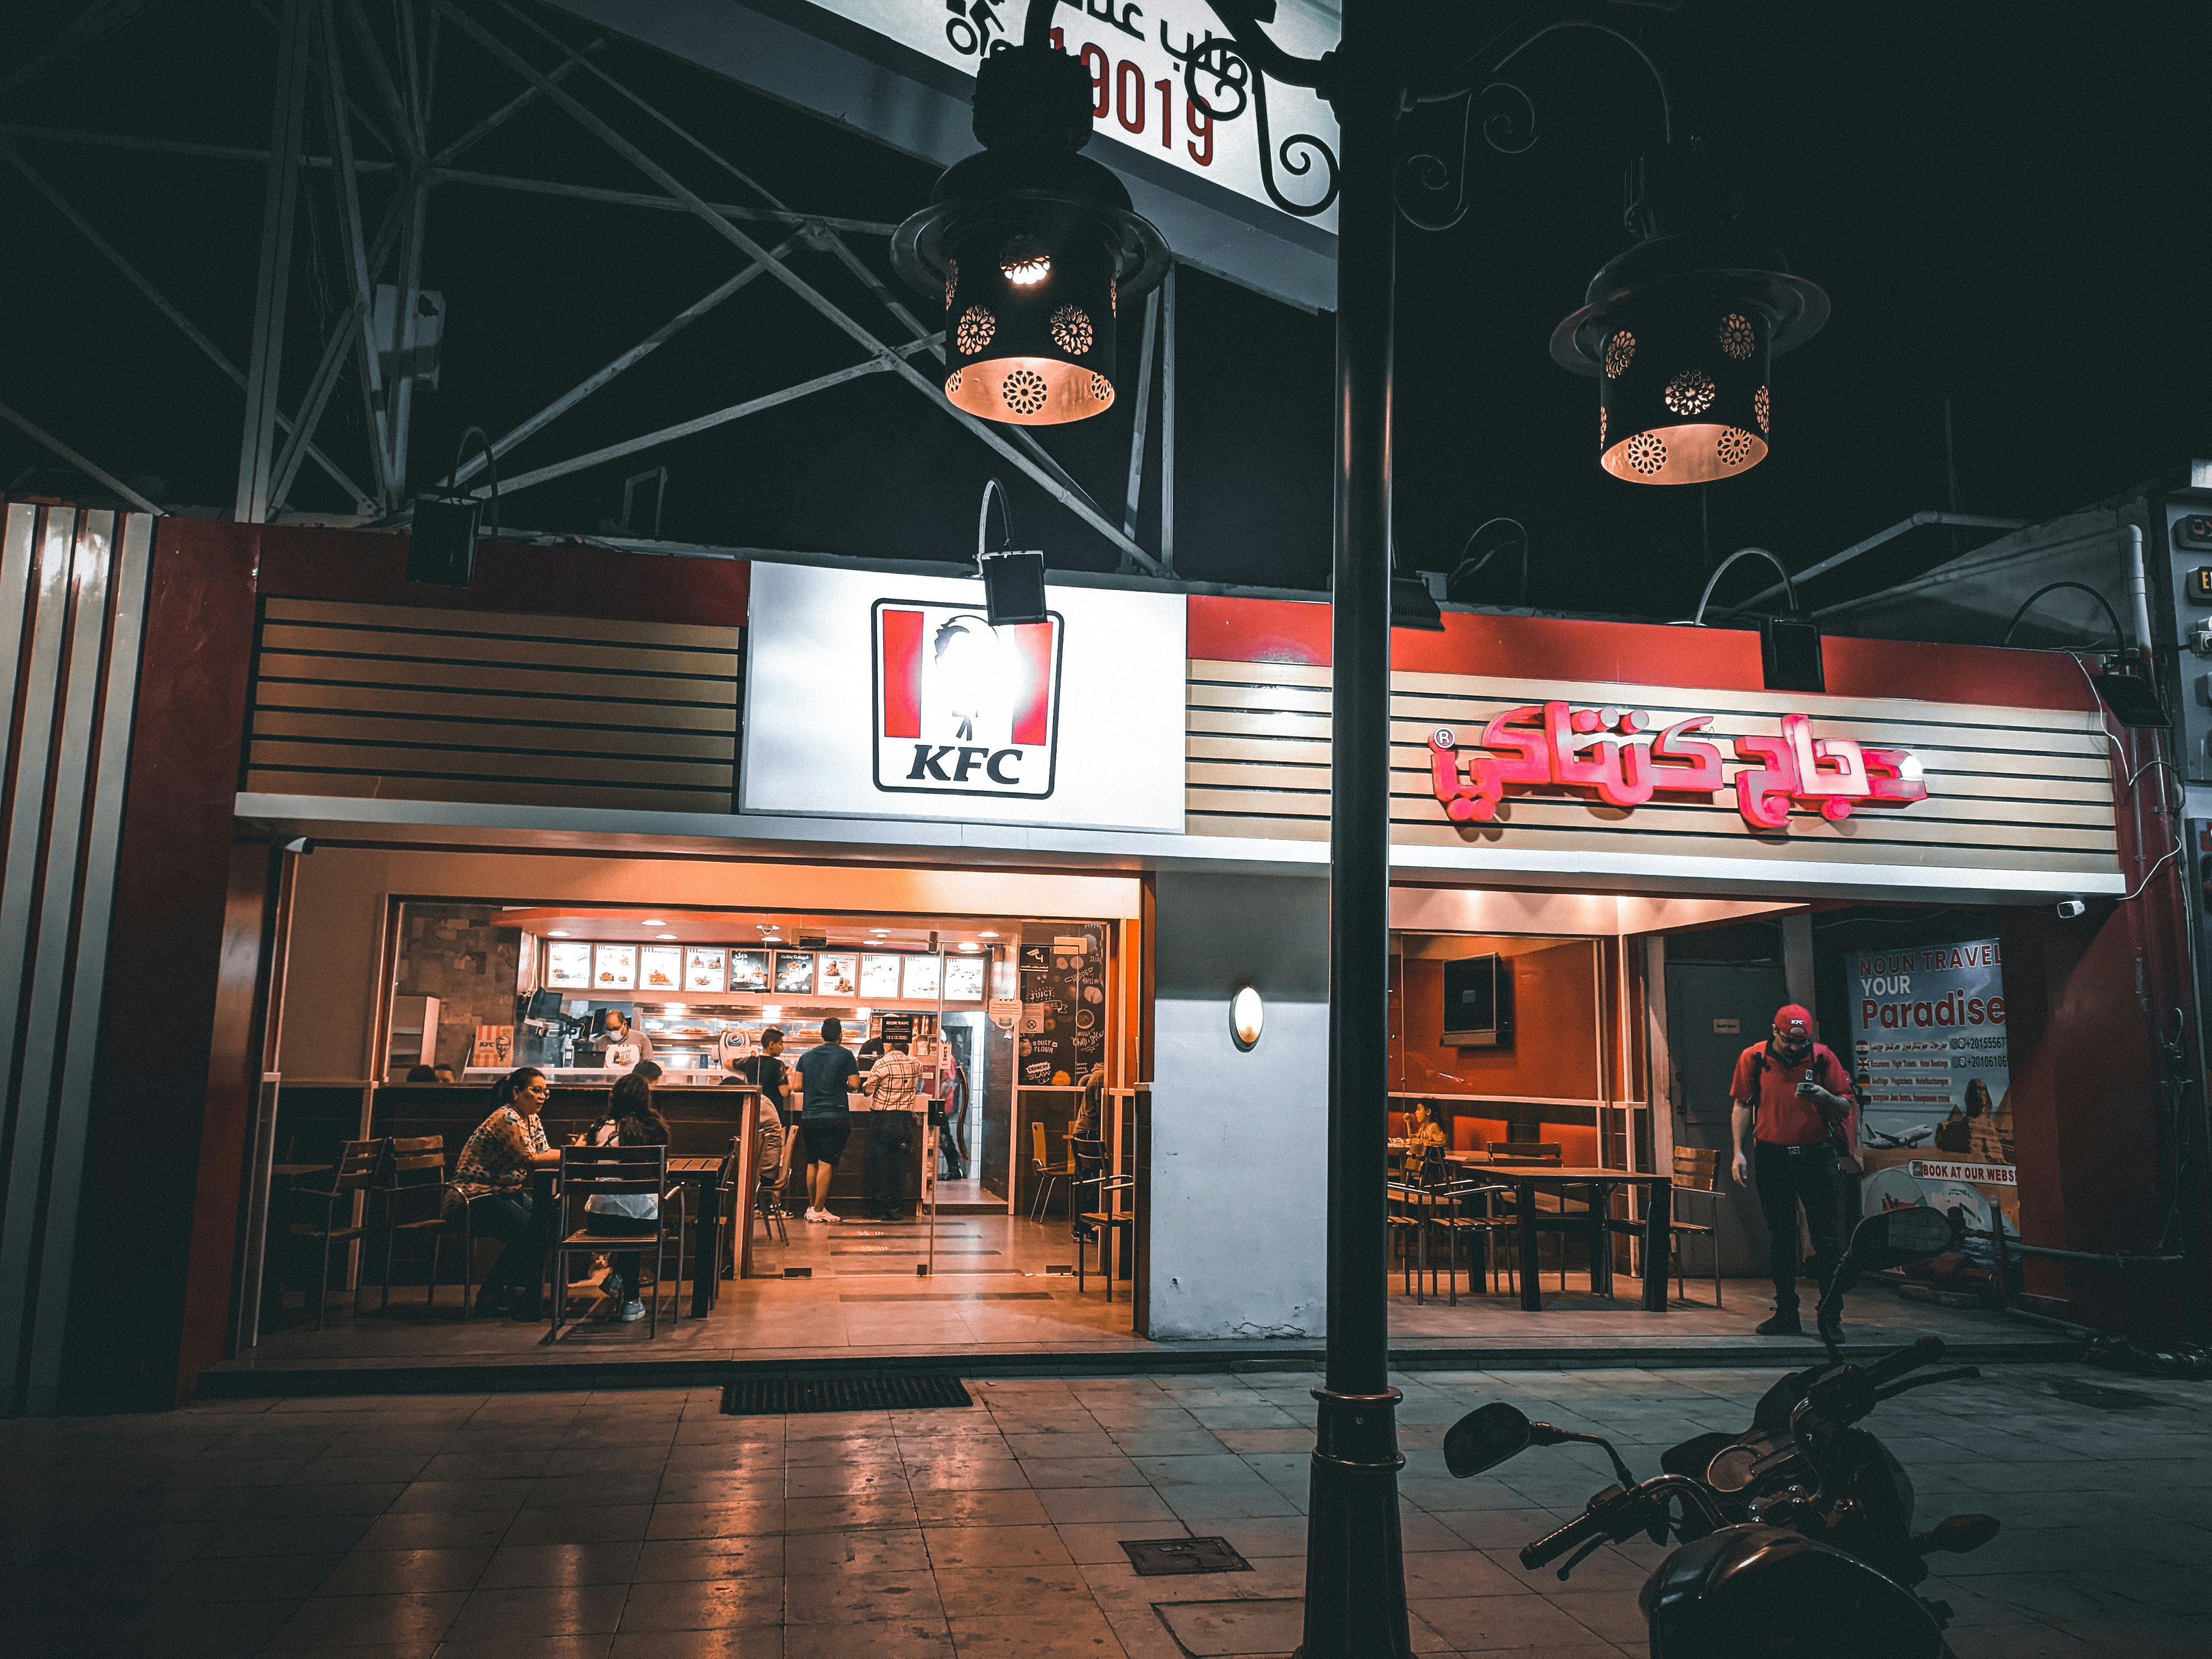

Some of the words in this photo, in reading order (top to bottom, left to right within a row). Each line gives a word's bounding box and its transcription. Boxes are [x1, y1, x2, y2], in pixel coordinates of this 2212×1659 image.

[906, 744, 1023, 785] KFC
[1431, 701, 1723, 822] كنتاكي
[1859, 953, 1916, 977] NOUN
[1922, 943, 2001, 972] TRAVEL
[1030, 989, 1052, 1000] JUICY
[1861, 975, 1911, 996] YOUR
[1861, 988, 2006, 1030] Paradise
[1965, 1036, 2007, 1050] +20155567
[1966, 1055, 2008, 1068] +20106106
[1029, 1071, 1051, 1080] SLAW
[1923, 1164, 1948, 1177] BOOK
[1951, 1166, 1961, 1178] AT
[1964, 1167, 1985, 1180] OUR
